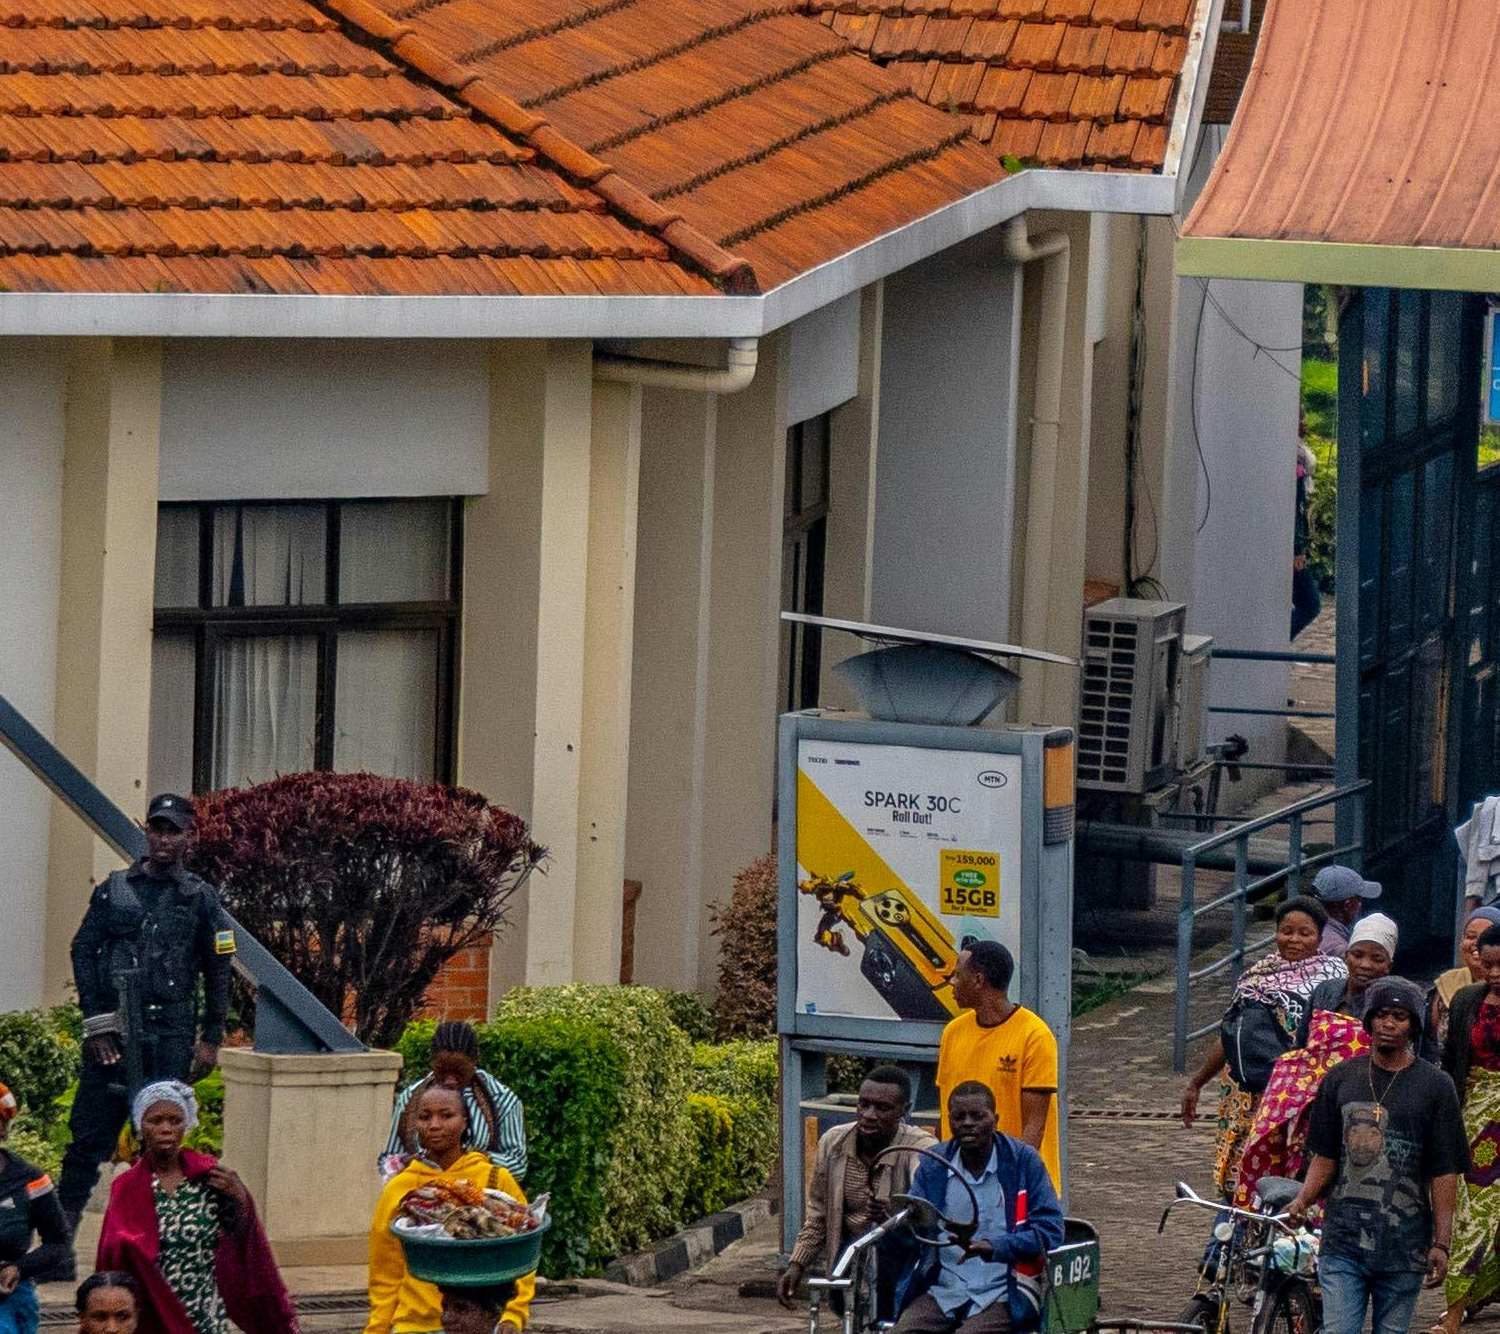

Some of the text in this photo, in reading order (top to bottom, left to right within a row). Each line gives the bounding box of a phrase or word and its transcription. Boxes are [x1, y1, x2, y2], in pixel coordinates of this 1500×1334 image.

[984, 775, 1001, 784] MTN
[864, 790, 962, 814] SPARK 30C
[892, 810, 933, 825] Roll Out!
[944, 887, 996, 907] 15GB
[1054, 1255, 1092, 1287] B 192
